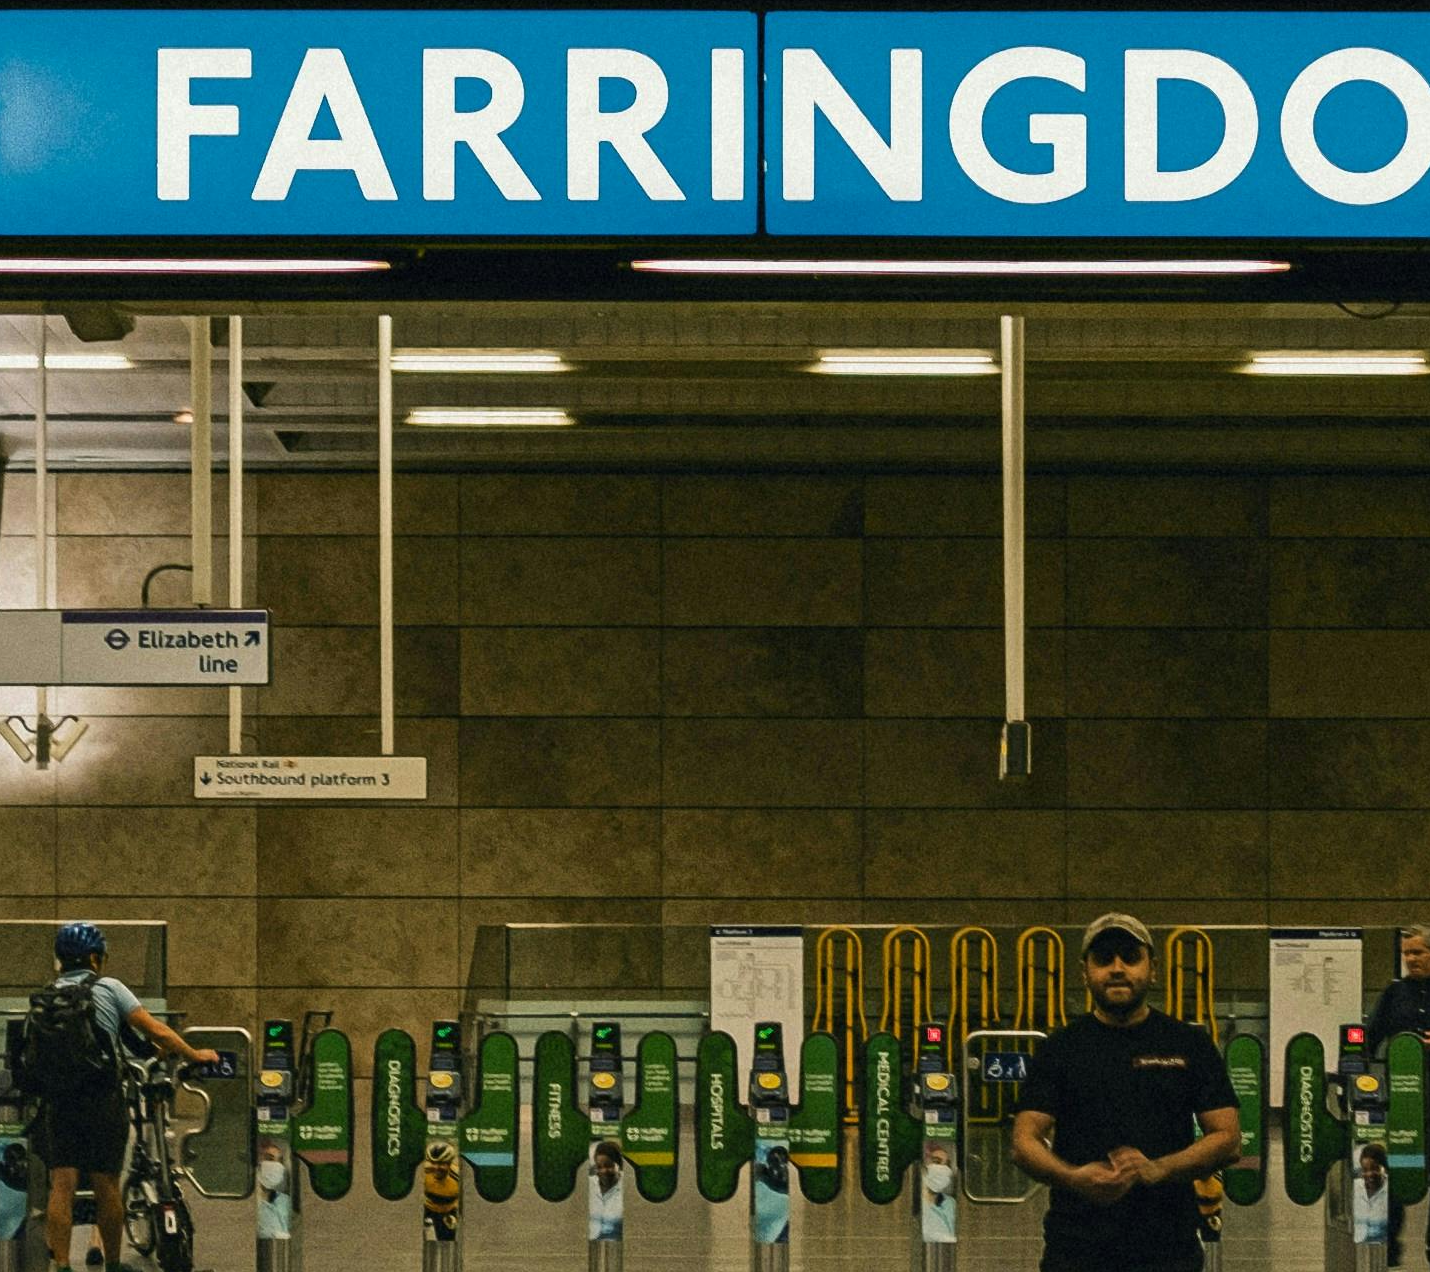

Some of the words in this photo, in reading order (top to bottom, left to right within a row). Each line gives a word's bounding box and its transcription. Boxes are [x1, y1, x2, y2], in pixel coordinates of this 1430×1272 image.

[139, 629, 239, 649] Elizabeth
[200, 654, 239, 674] line
[216, 760, 259, 769] National
[262, 760, 280, 769] Rail
[216, 772, 305, 785] Southbound
[310, 772, 377, 787] platform
[381, 773, 390, 785] 3
[387, 1059, 401, 1157] DIAGNOSTICS
[547, 1082, 562, 1139] FITNESS
[710, 1073, 725, 1150] HOSPITALS
[876, 1051, 891, 1115] MEDICAL
[1299, 1065, 1314, 1164] DIAGNOSTICS
[876, 1119, 891, 1183] CENTRES
